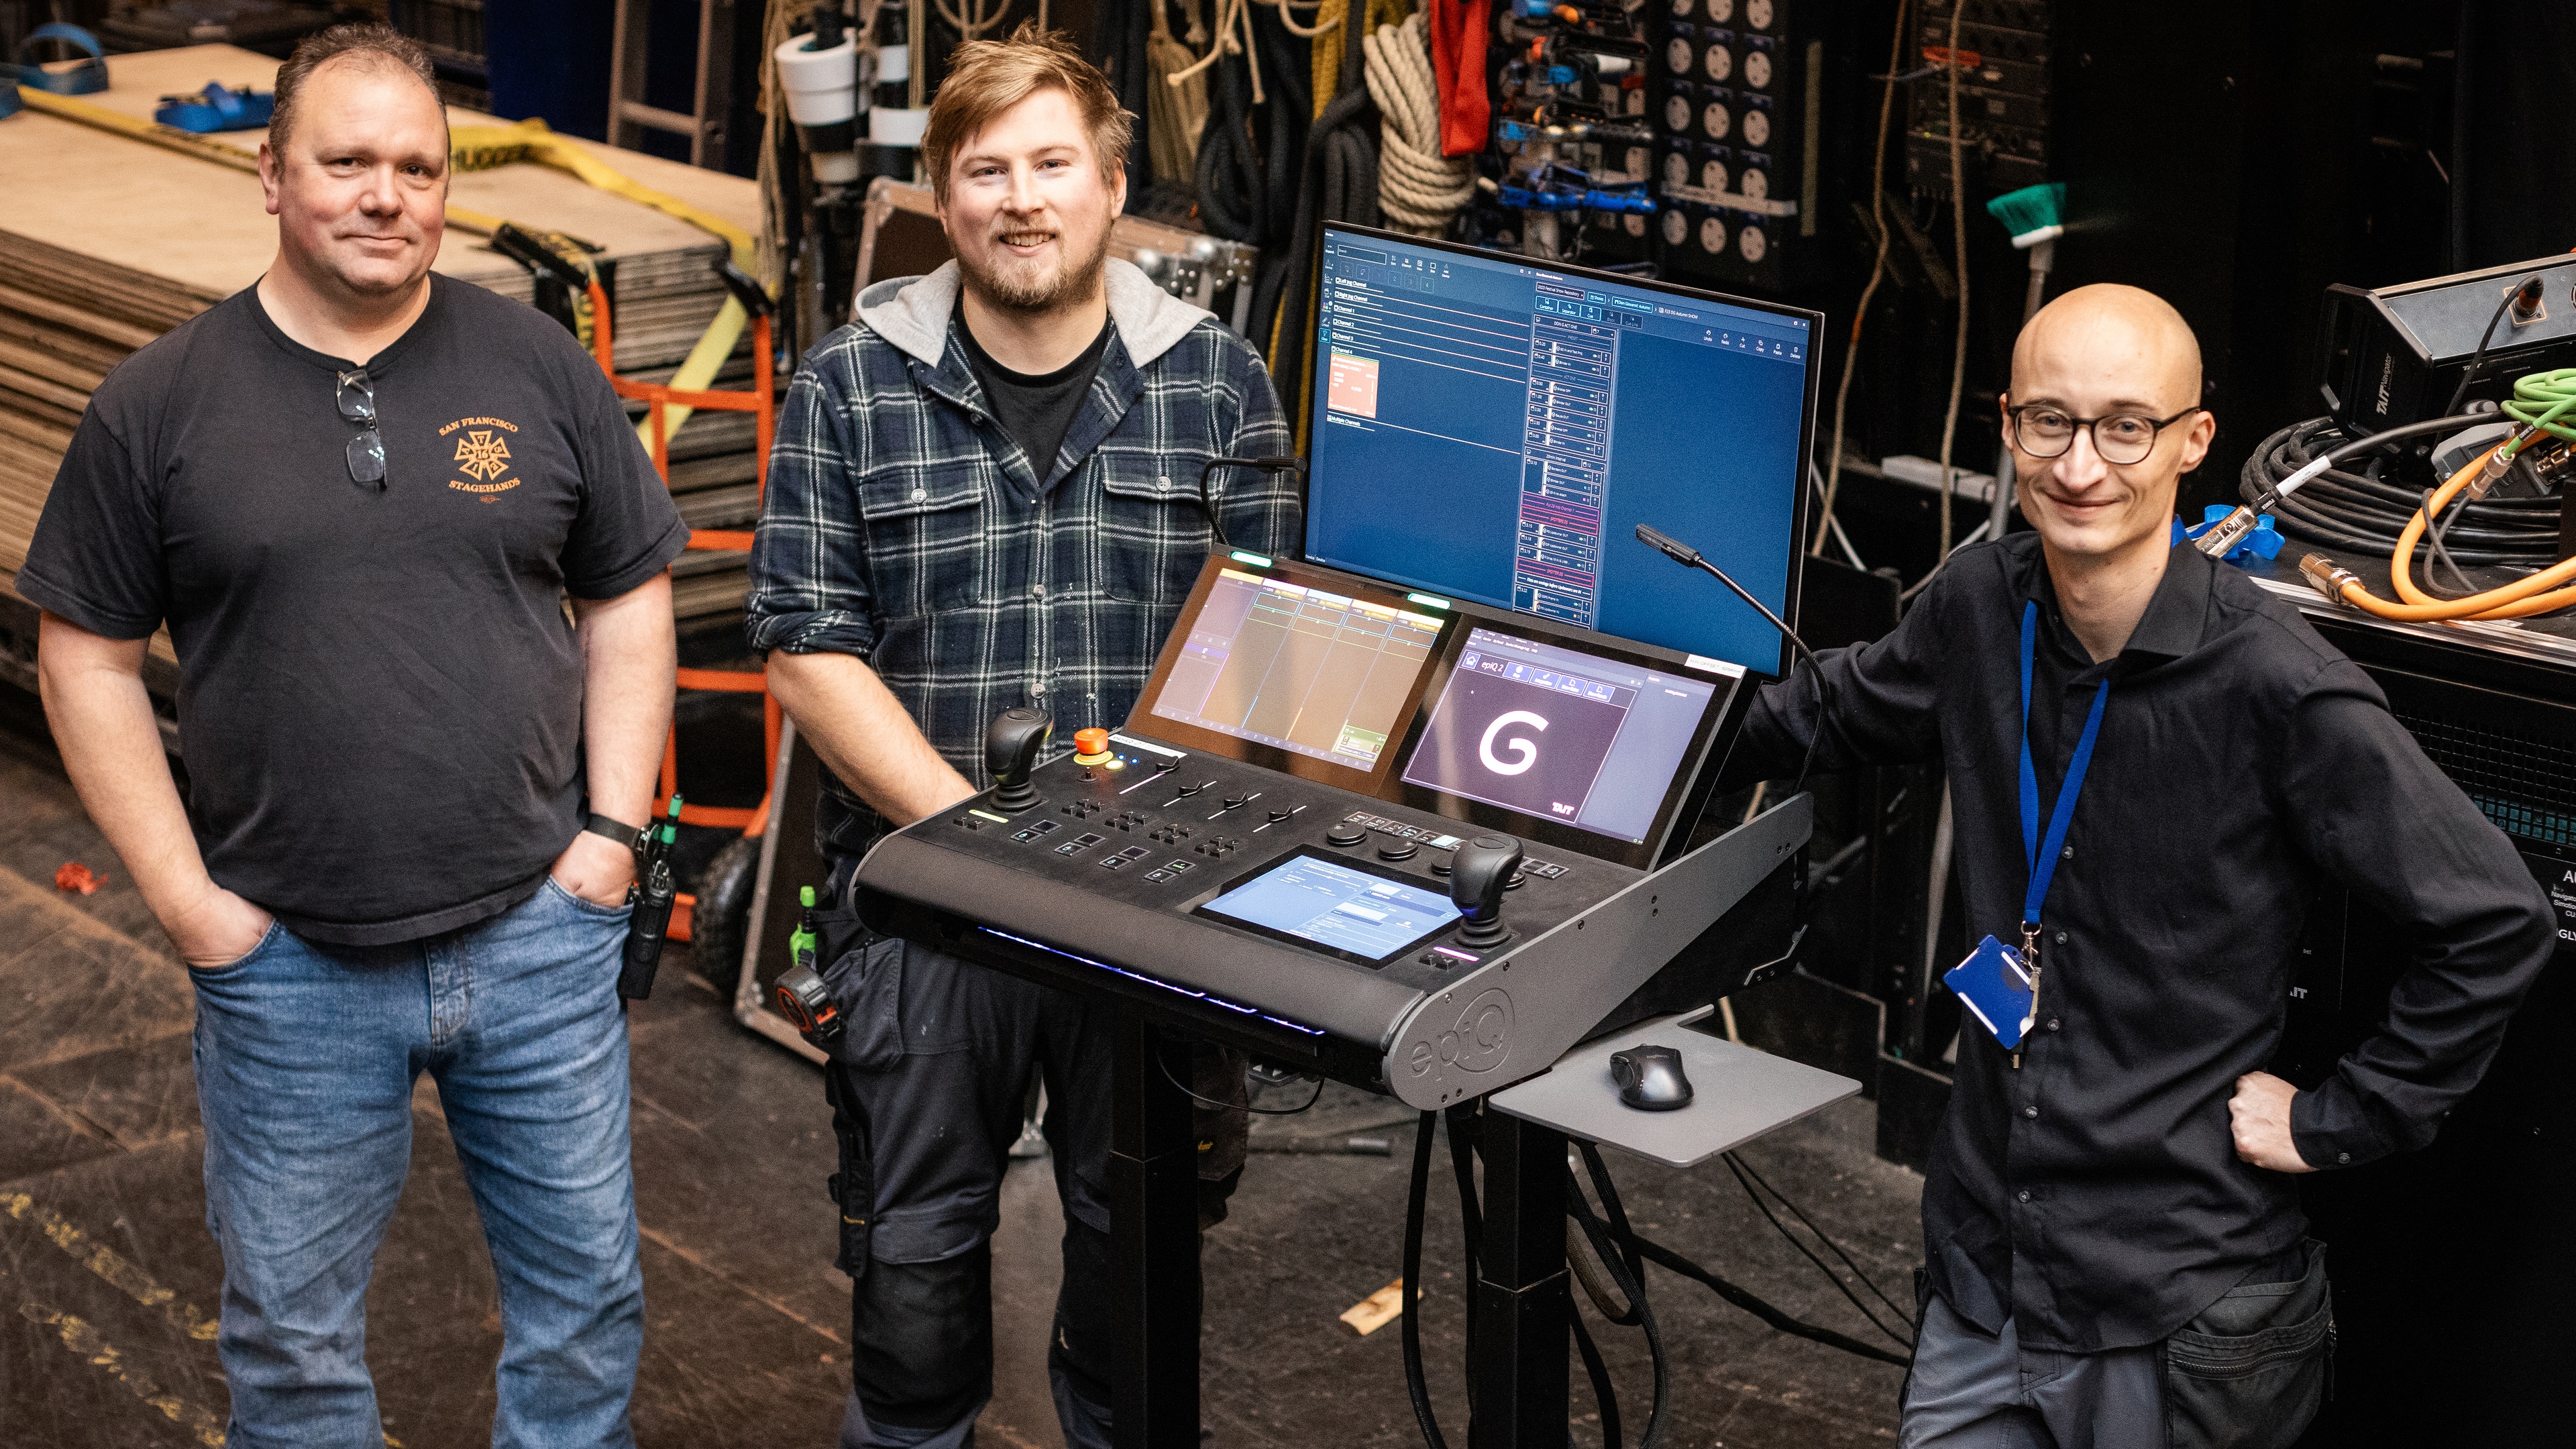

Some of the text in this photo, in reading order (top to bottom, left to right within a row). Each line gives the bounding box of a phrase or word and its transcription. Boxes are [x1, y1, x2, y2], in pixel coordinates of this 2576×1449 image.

[1564, 290, 1580, 298] Repository
[2381, 352, 2392, 388] Navigator
[2376, 384, 2390, 415] TAIT
[439, 417, 519, 436] SAN FRANCISCO
[1332, 416, 1361, 427] Multiple Channels
[477, 450, 488, 459] 16
[448, 477, 521, 492] STAGEHANDS
[2261, 498, 2276, 511] POWER
[1481, 660, 1504, 672] epiQ 2
[1479, 710, 1549, 775] G
[1552, 802, 1574, 816] TAIT
